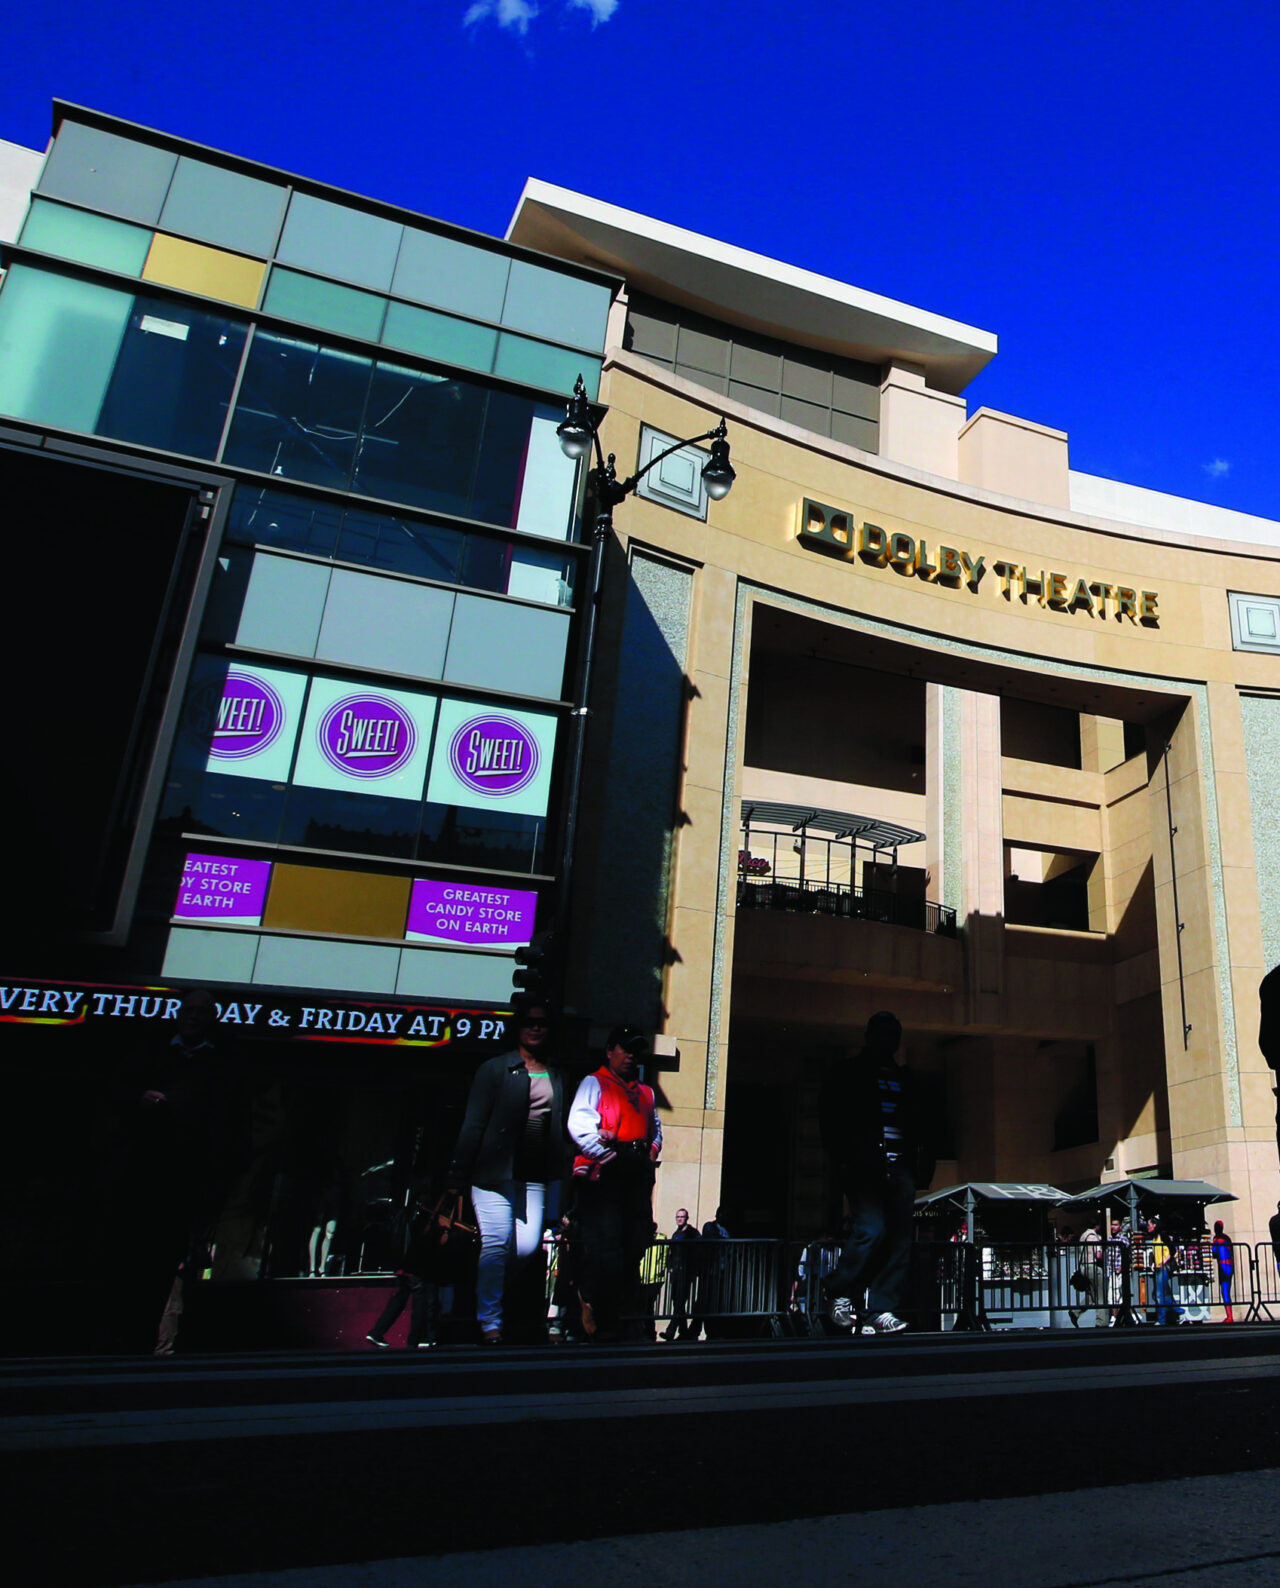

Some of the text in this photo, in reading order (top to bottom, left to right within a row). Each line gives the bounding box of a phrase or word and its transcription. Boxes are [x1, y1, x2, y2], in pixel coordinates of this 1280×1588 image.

[860, 522, 1160, 625] DOLBY THEATRE
[215, 697, 267, 732] WEET!
[200, 878, 252, 894] STORE
[182, 893, 234, 909] EARTH
[442, 888, 510, 905] GREATEST
[425, 902, 522, 923] CANDY STORE
[436, 918, 509, 936] ON EARTH
[92, 993, 263, 1025] THURAY
[268, 1008, 290, 1027] &
[299, 1007, 403, 1034] FRIDAY
[407, 1015, 445, 1036] AT
[456, 1018, 472, 1038] 9
